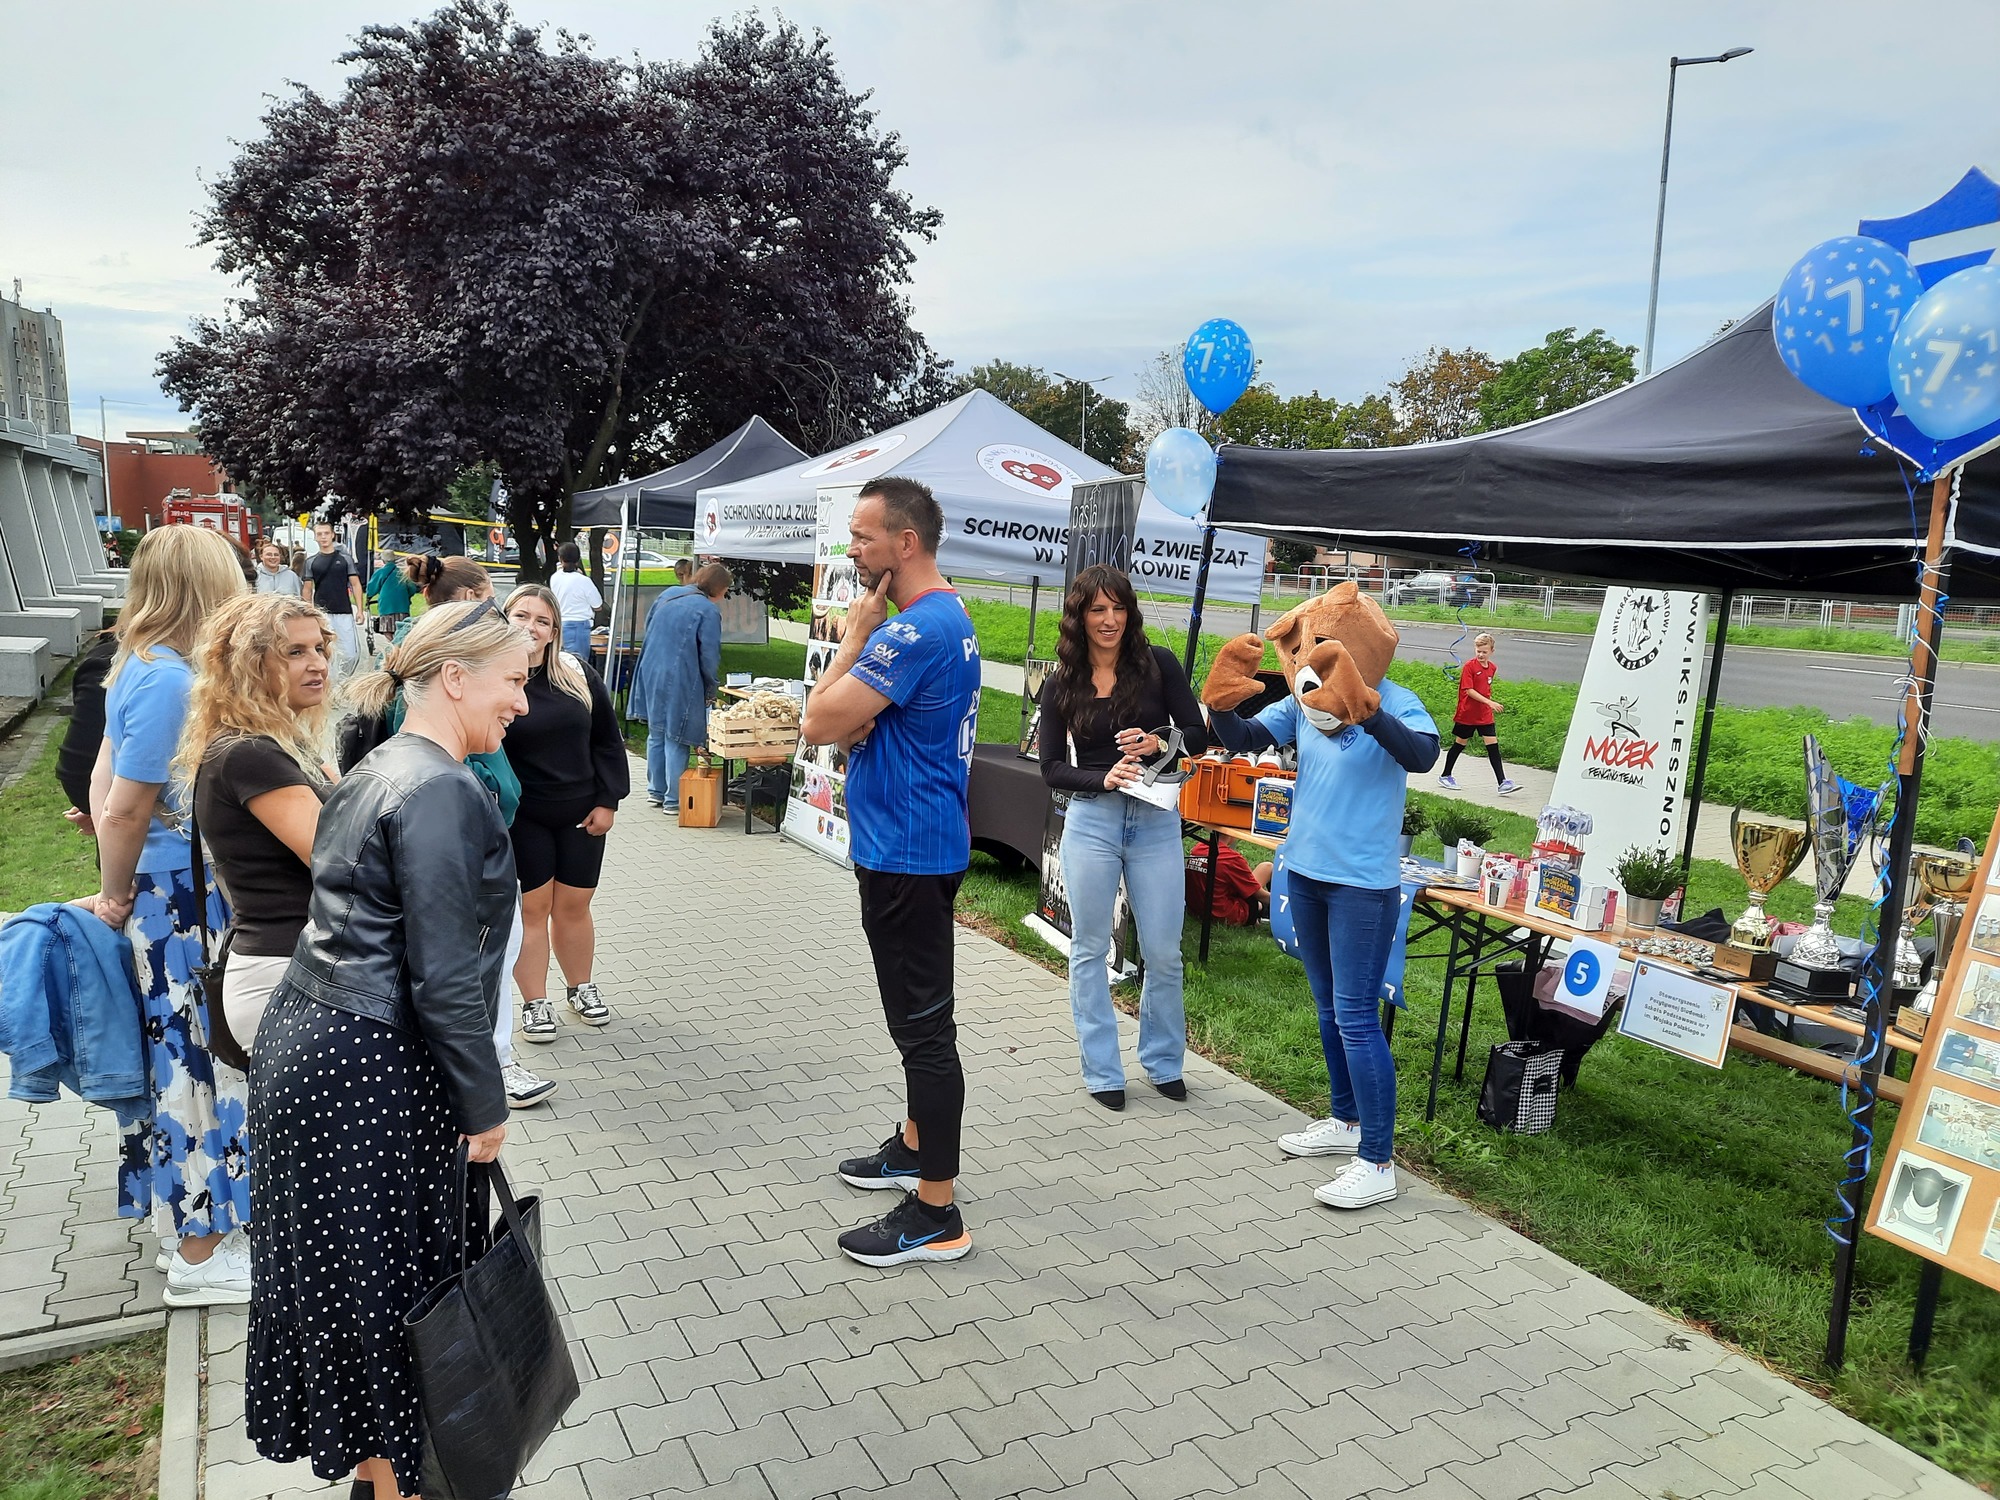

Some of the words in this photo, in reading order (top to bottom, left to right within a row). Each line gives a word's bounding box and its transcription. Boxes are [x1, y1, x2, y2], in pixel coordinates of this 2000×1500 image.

[1824, 276, 1865, 336] 7
[1197, 341, 1215, 374] 7
[1925, 338, 1962, 393] 7
[723, 504, 773, 521] SCHRONISKO
[775, 504, 793, 521] DLA
[795, 504, 817, 521] ZWIE
[963, 516, 1069, 547] SCHRONIS
[1033, 546, 1055, 563] W
[1661, 591, 1671, 636] ORTOWY
[1614, 649, 1657, 671] LESZNO
[1583, 735, 1659, 770] MOCEK
[1619, 773, 1643, 785] TEAM
[1279, 894, 1289, 913] 7
[1573, 962, 1590, 985] 5
[1653, 1015, 1673, 1027] Wojska
[1673, 1021, 1700, 1036] Polskiego
[1663, 1009, 1695, 1026] Podstawowa
